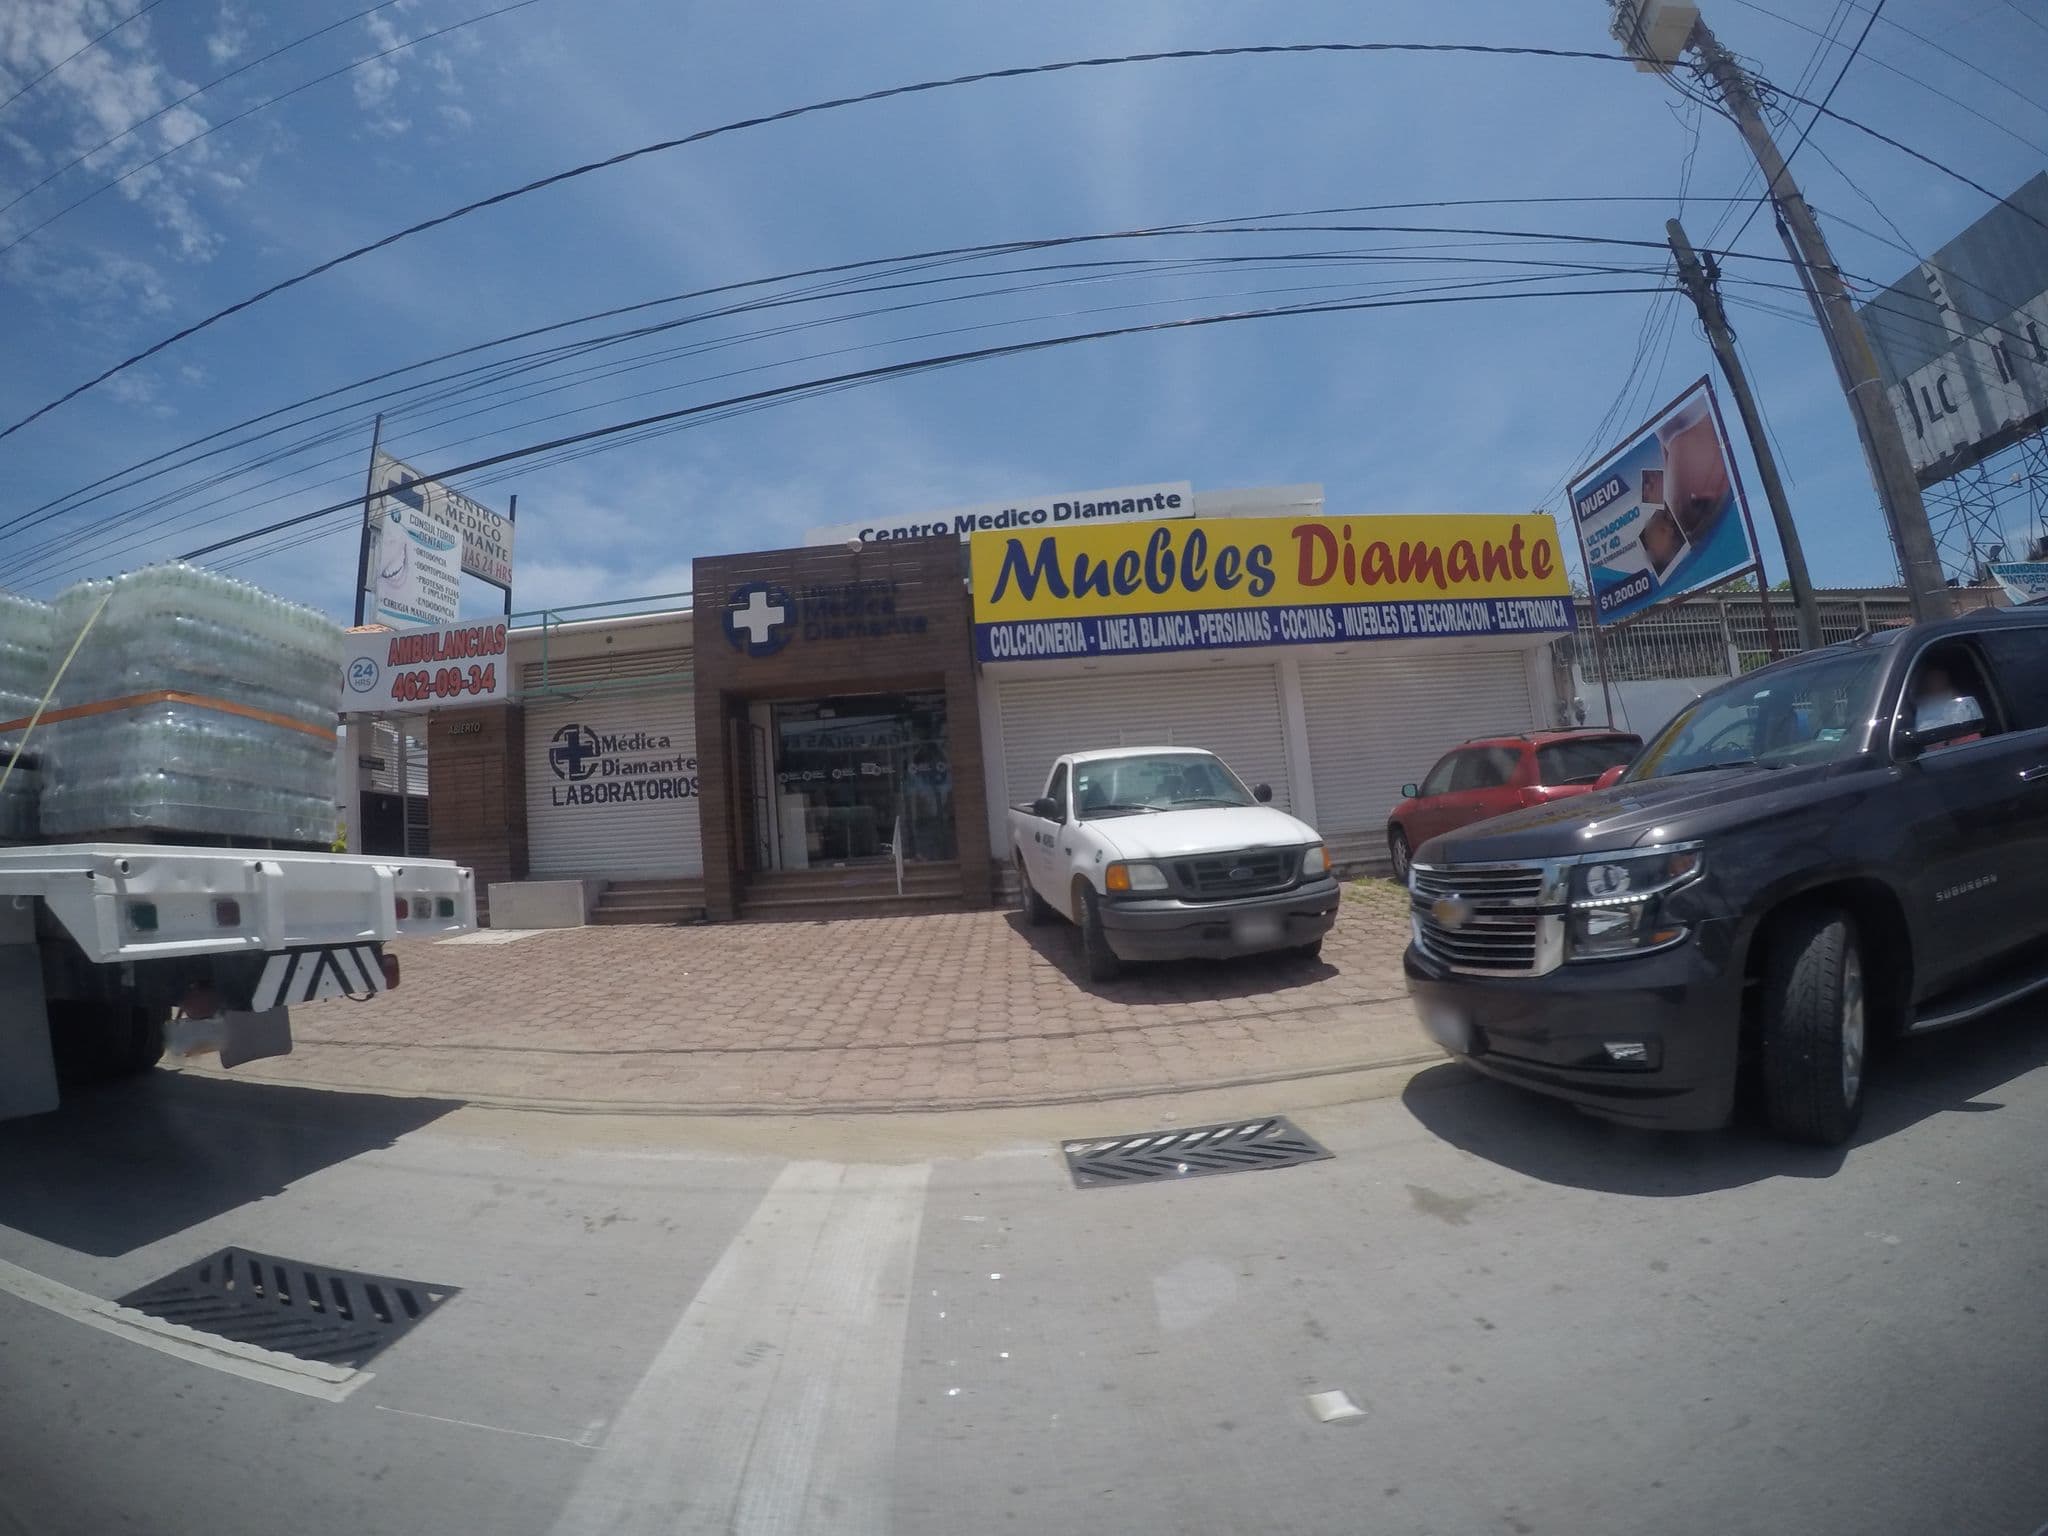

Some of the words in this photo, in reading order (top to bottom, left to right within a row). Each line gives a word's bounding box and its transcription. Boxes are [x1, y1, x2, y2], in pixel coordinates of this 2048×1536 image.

[447, 490, 501, 527] CENTRO
[1580, 479, 1620, 517] NUEVO
[410, 514, 456, 545] CONSULTORIO
[445, 504, 501, 543] MEDICO
[858, 522, 948, 543] Centro
[953, 508, 1047, 533] Medico
[1053, 492, 1181, 521] Diamante
[418, 531, 446, 552] DENTAL
[495, 563, 513, 583] HRS
[990, 527, 1276, 604] Muebles
[1291, 523, 1554, 590] Diamante
[1601, 576, 1649, 610] $1,200.00
[387, 623, 507, 668] AMBULANCIAS
[990, 621, 1087, 658] COLCHONERIA
[1097, 617, 1139, 650] LINEA
[1140, 614, 1194, 648] BLANCA
[1200, 610, 1272, 645] PERSIANAS
[1279, 607, 1336, 640] COCINAS
[1343, 604, 1399, 637] MUEBLES
[1400, 604, 1415, 634] DE
[1417, 602, 1490, 633] DECORACION
[1499, 599, 1569, 630] ELECTRONICA
[353, 664, 374, 678] 24
[391, 662, 497, 702] 462-09-34
[601, 732, 671, 753] Médica
[602, 754, 697, 776] Diamante
[552, 777, 700, 806] LABORATORIOS
